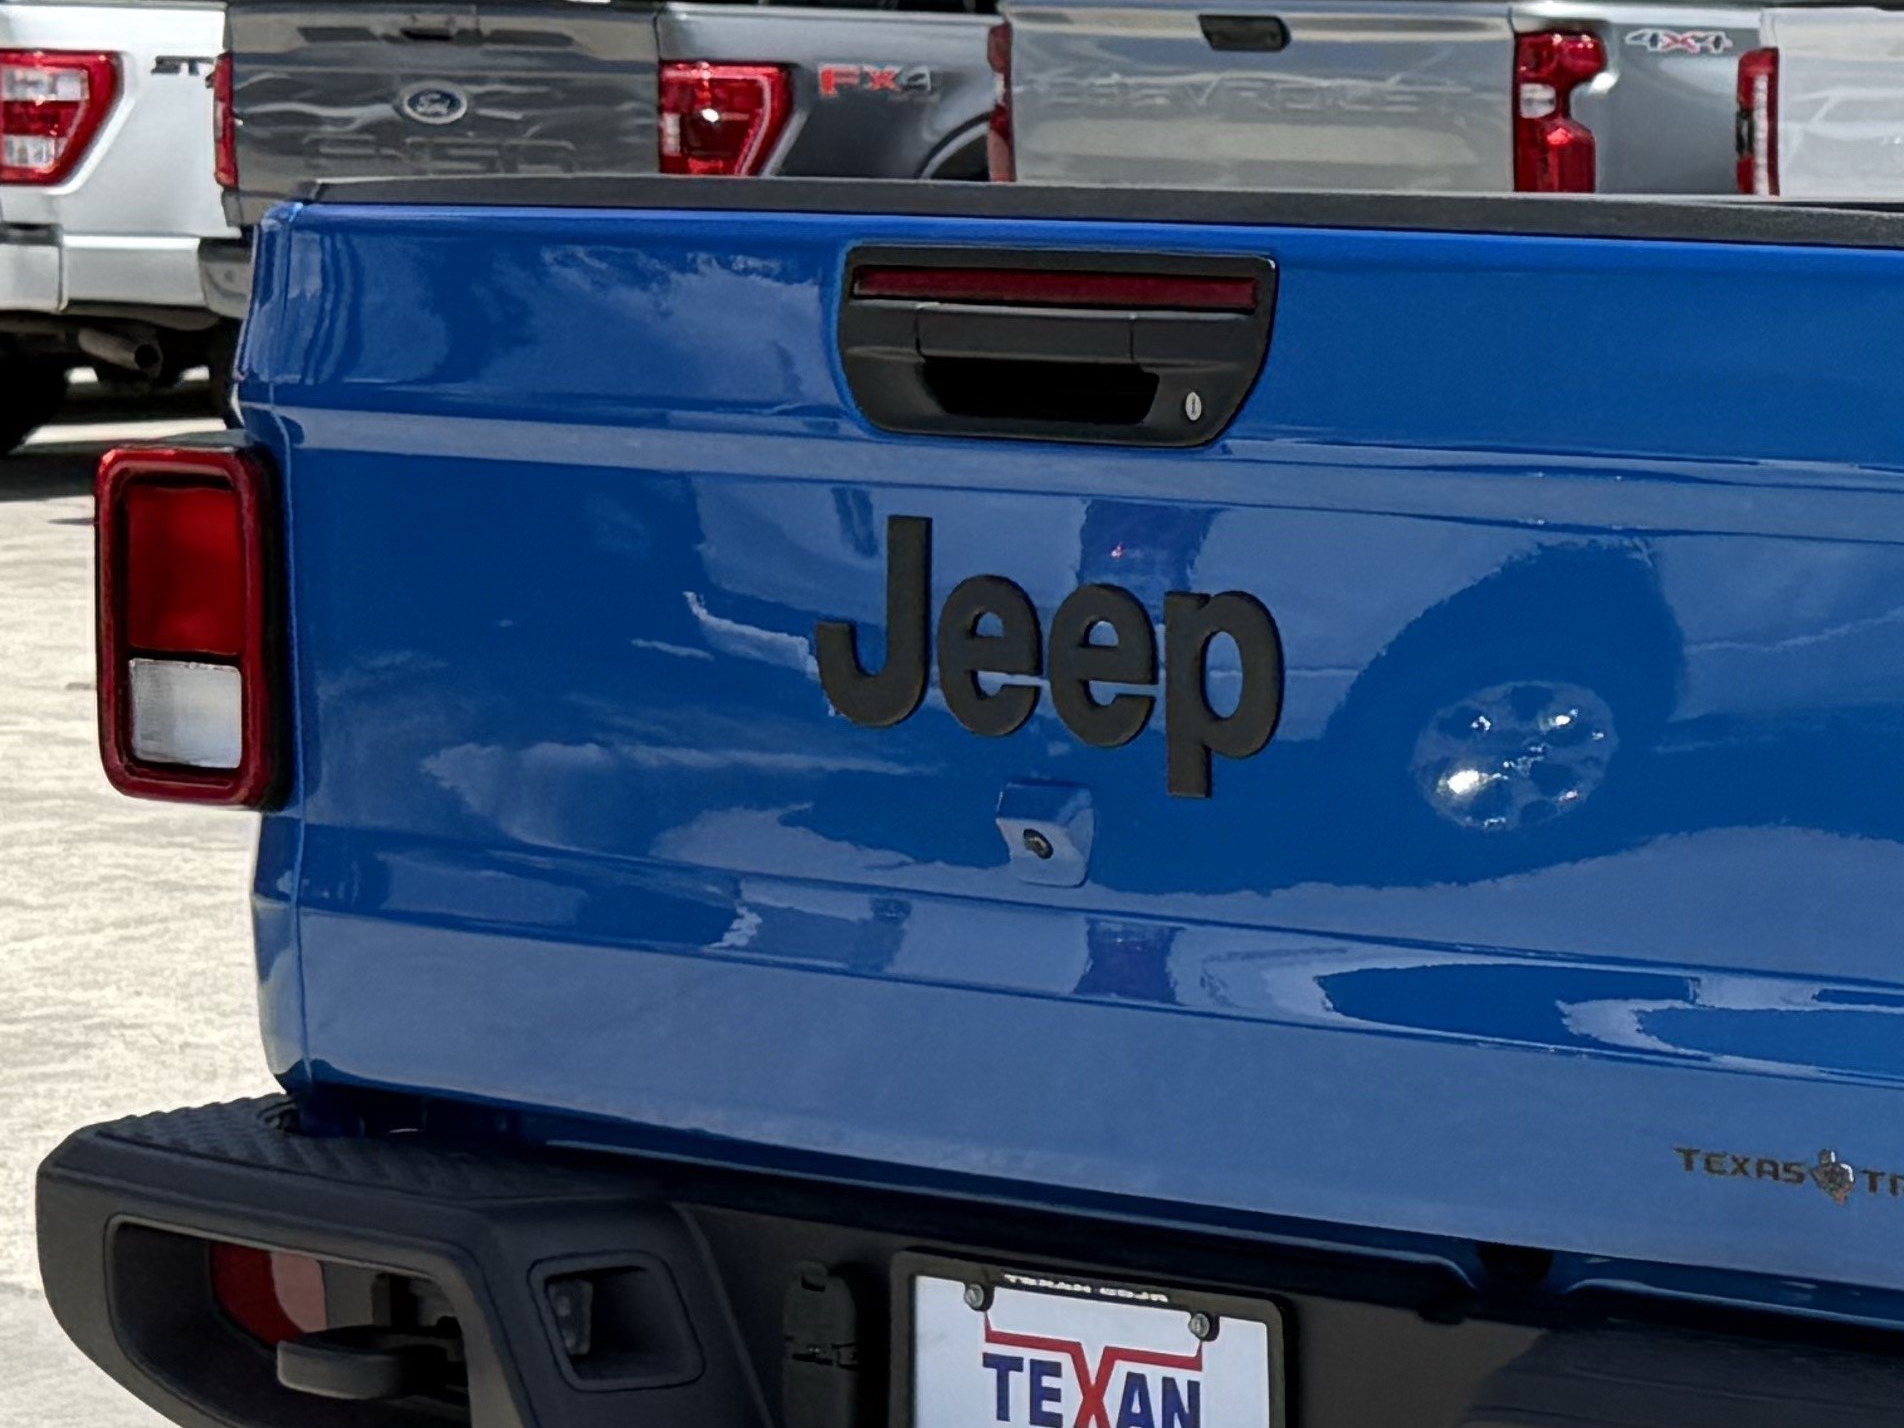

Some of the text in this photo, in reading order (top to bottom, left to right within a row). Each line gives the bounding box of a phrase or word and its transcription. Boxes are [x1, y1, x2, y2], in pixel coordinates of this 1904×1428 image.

[817, 63, 931, 96] FX4
[815, 515, 1284, 798] Jeep
[1672, 1145, 1806, 1185] TEXAS
[1003, 1273, 1092, 1294] TEXAN
